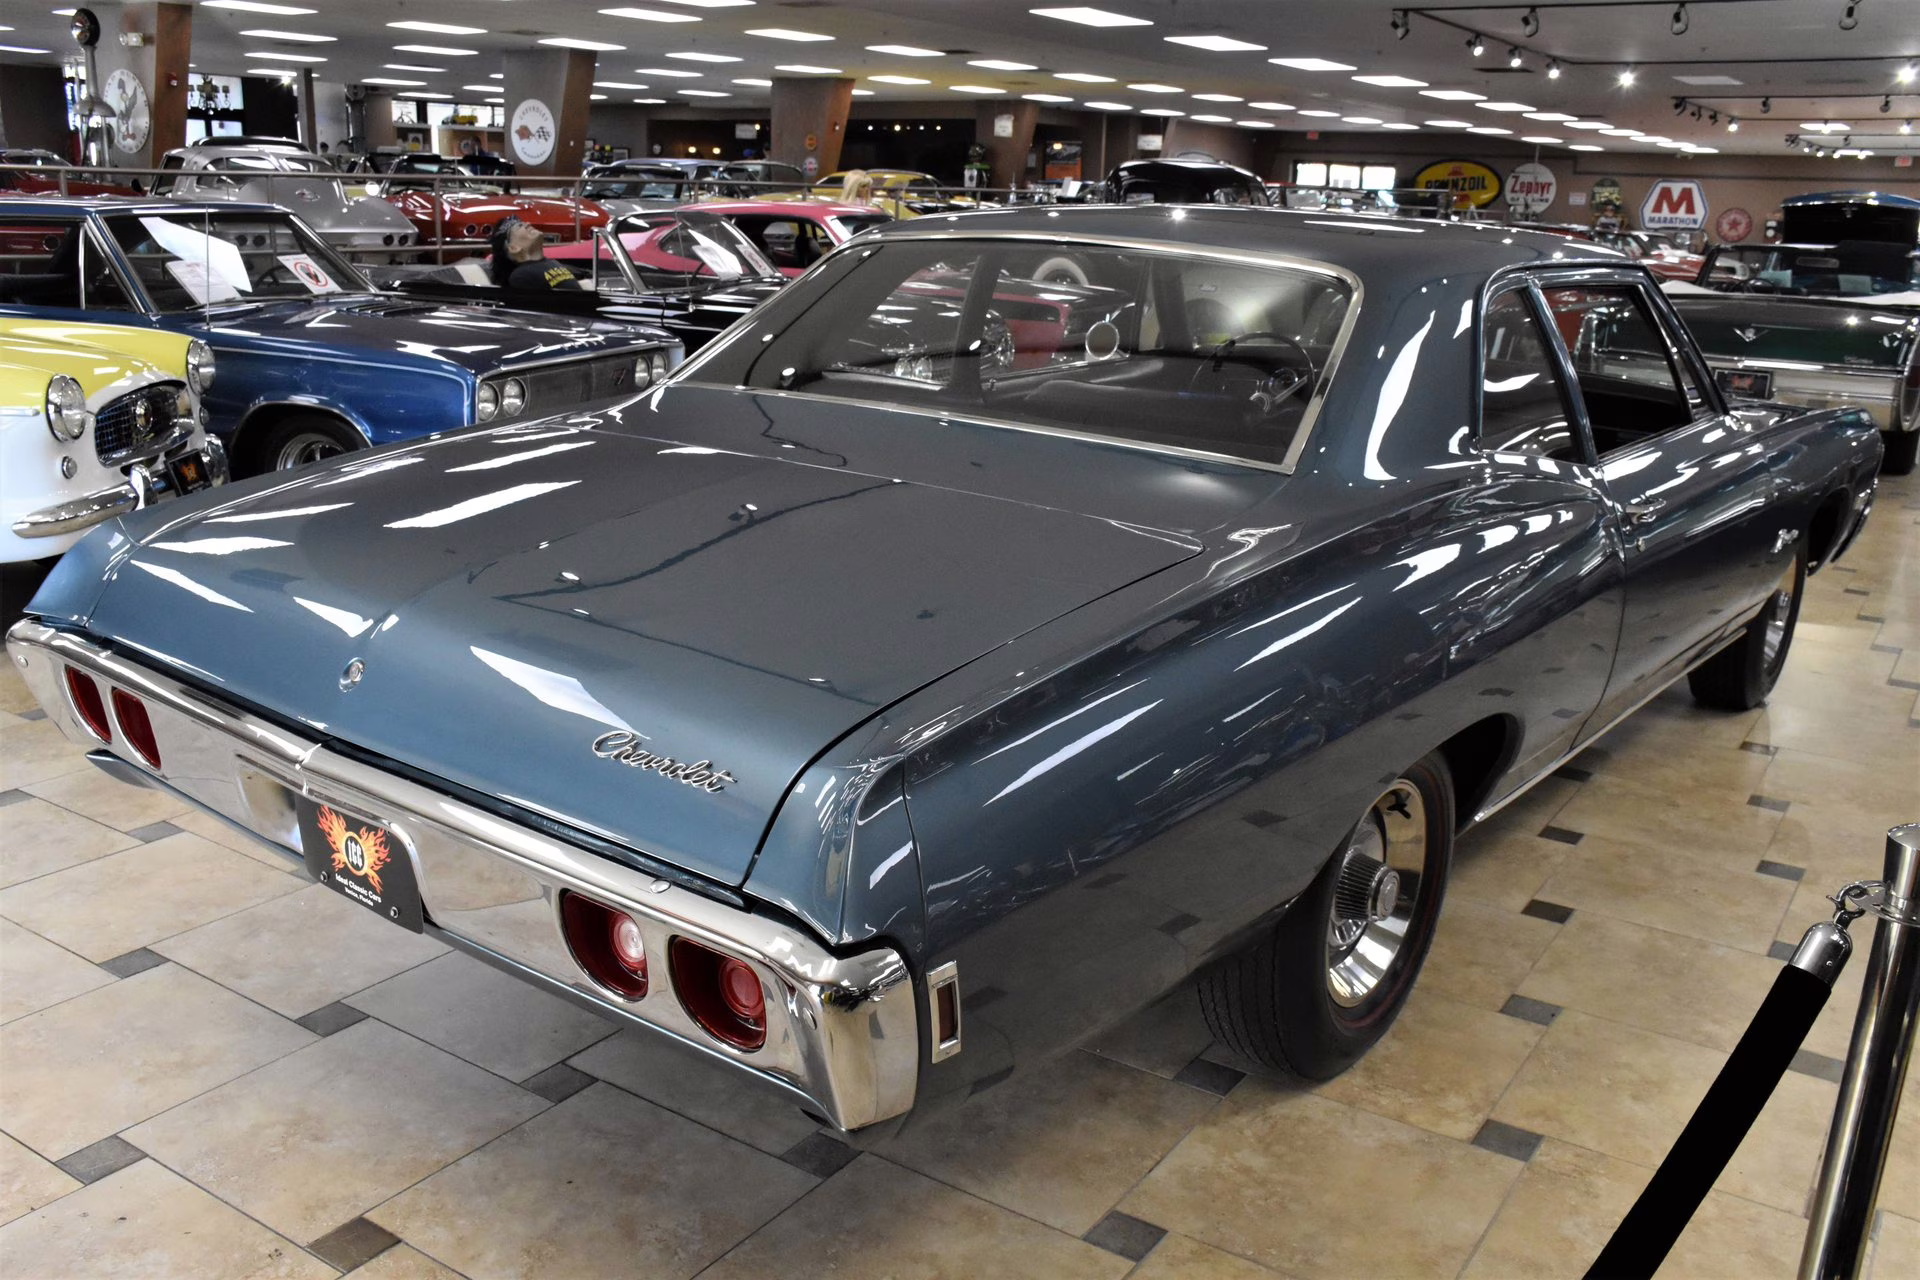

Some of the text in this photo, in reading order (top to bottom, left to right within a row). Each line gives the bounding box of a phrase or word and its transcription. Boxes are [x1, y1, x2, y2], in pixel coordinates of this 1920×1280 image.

[1510, 175, 1553, 197] Zephyr
[1647, 216, 1698, 226] MARATHON
[592, 730, 738, 793] Chevrolet
[335, 872, 382, 903] Ideal Classic Cars
